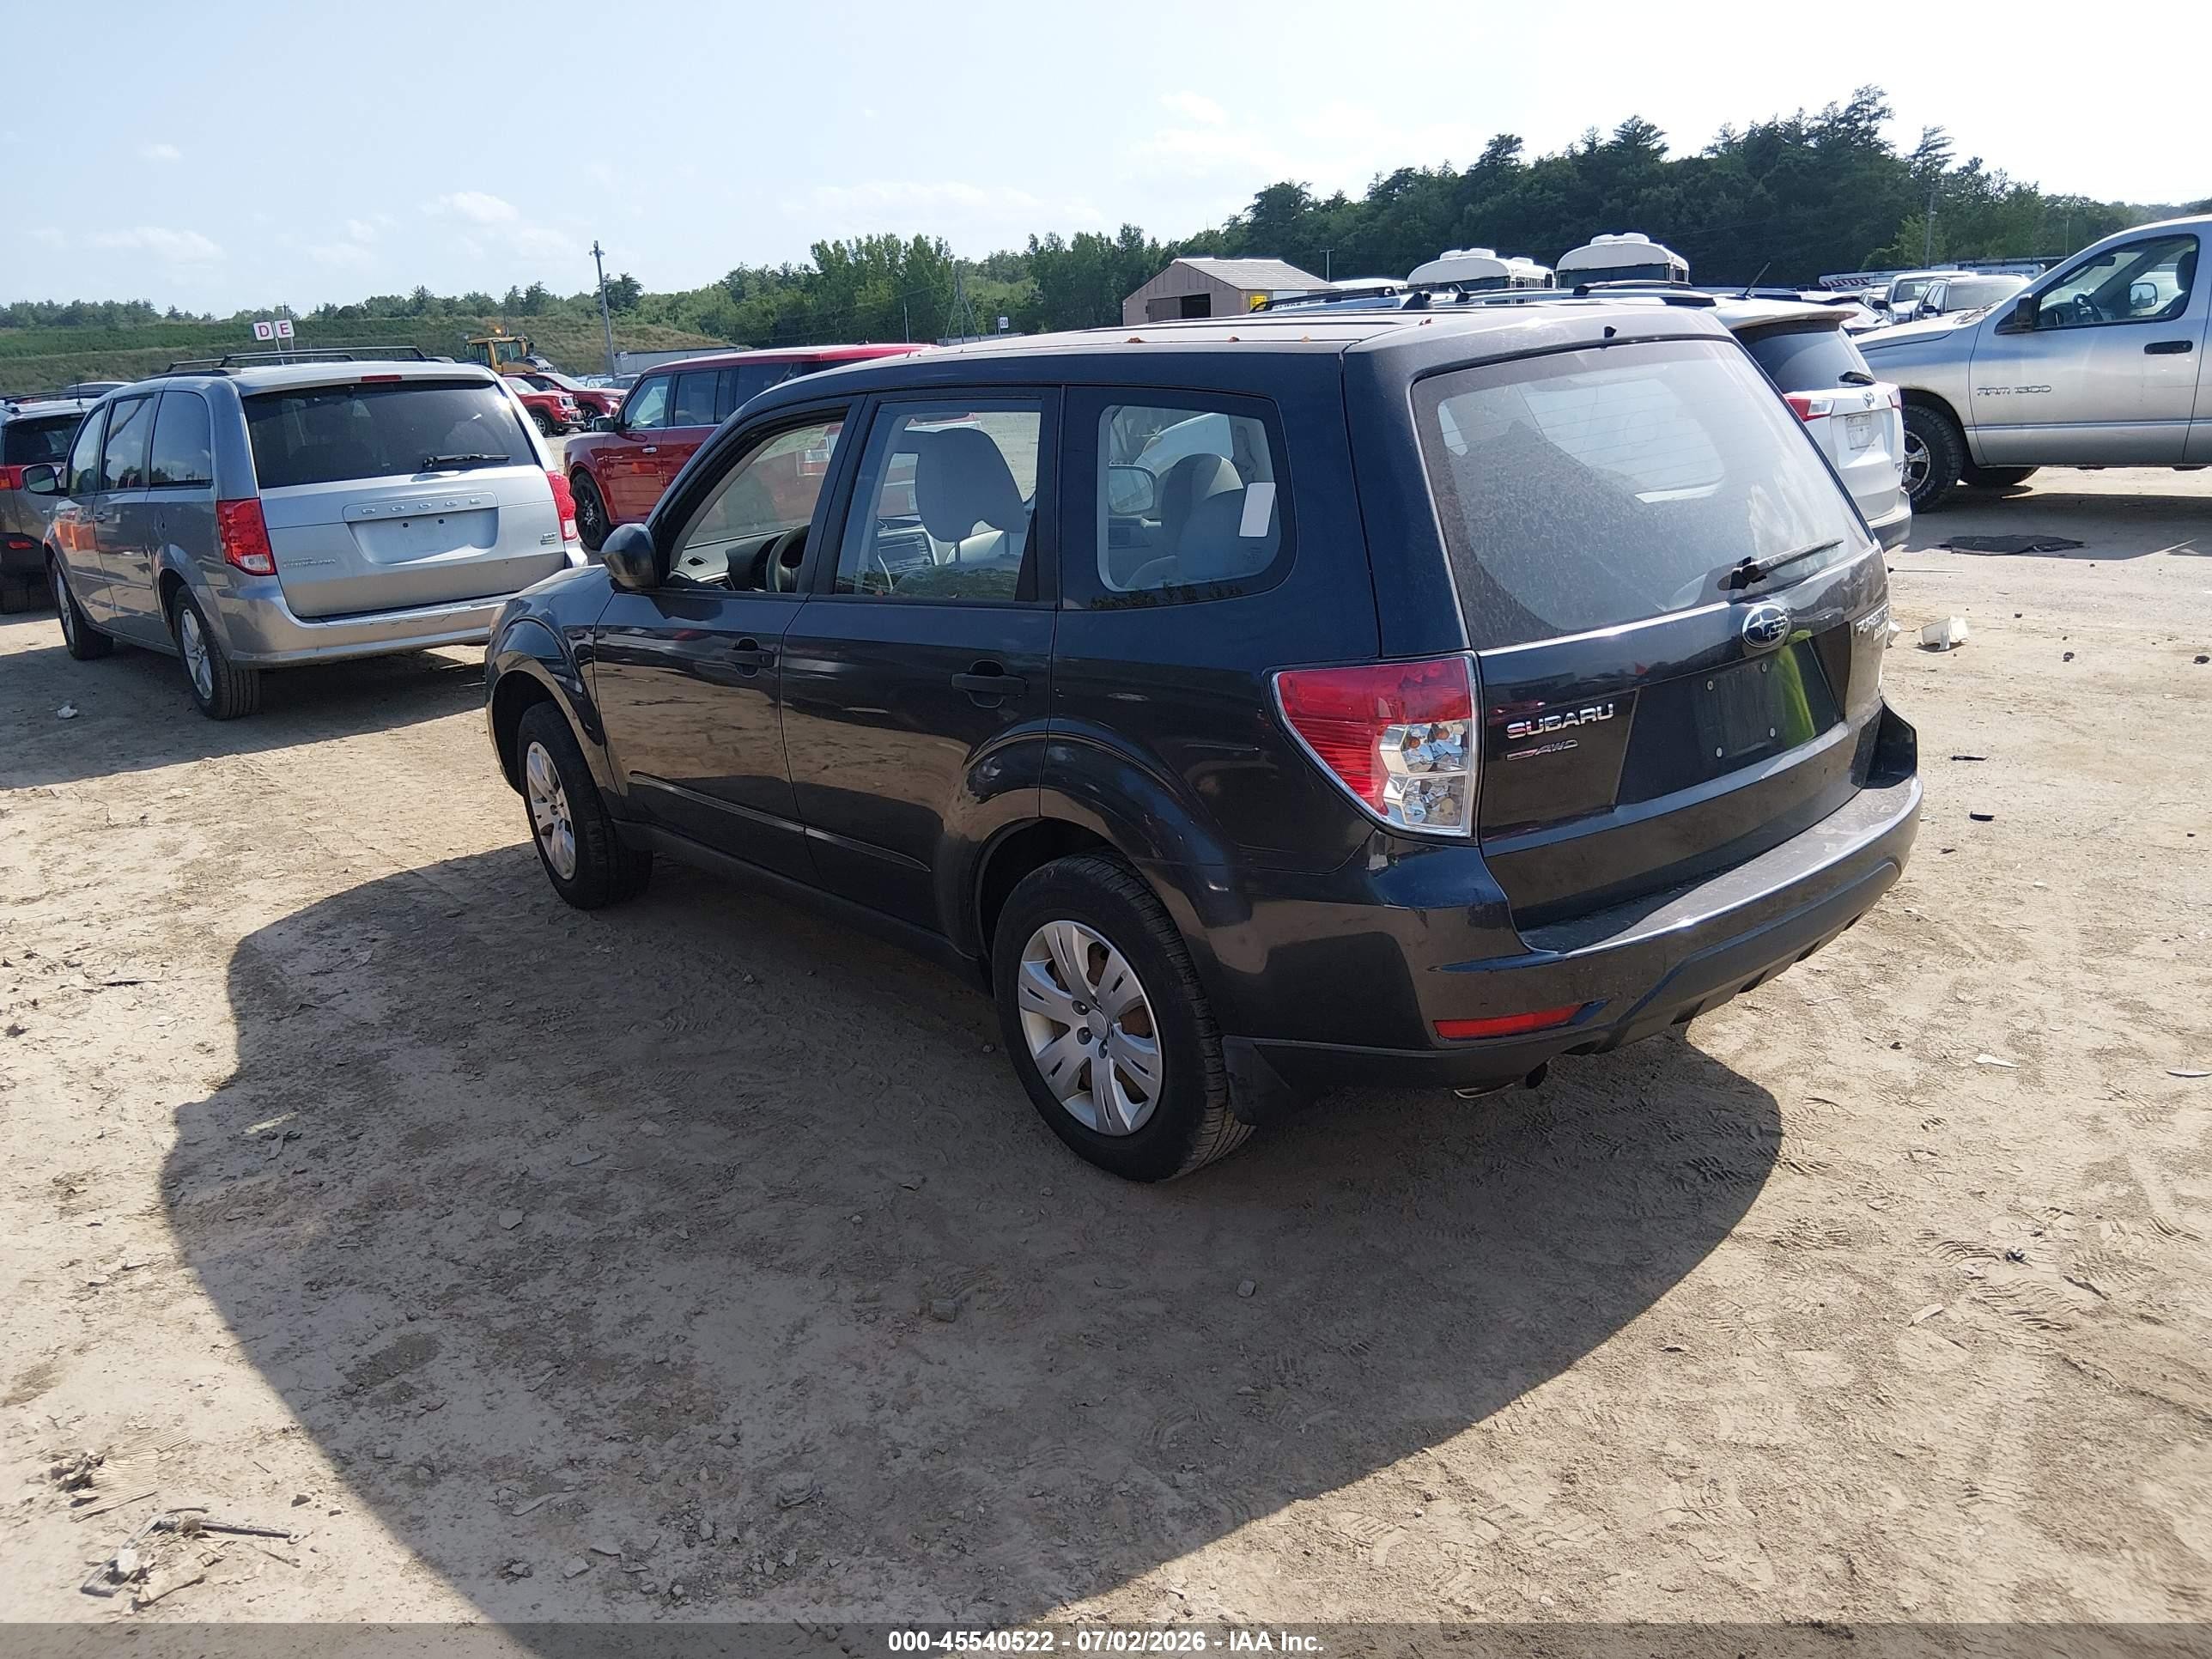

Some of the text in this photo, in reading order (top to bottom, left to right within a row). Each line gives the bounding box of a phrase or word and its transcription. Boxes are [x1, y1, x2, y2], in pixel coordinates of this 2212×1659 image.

[258, 325, 270, 337] D
[279, 323, 291, 336] E
[1977, 385, 2052, 396] RAM 1500
[362, 497, 482, 514] DODGE
[1506, 702, 1614, 739] SUBARU
[1534, 738, 1579, 756] AWD
